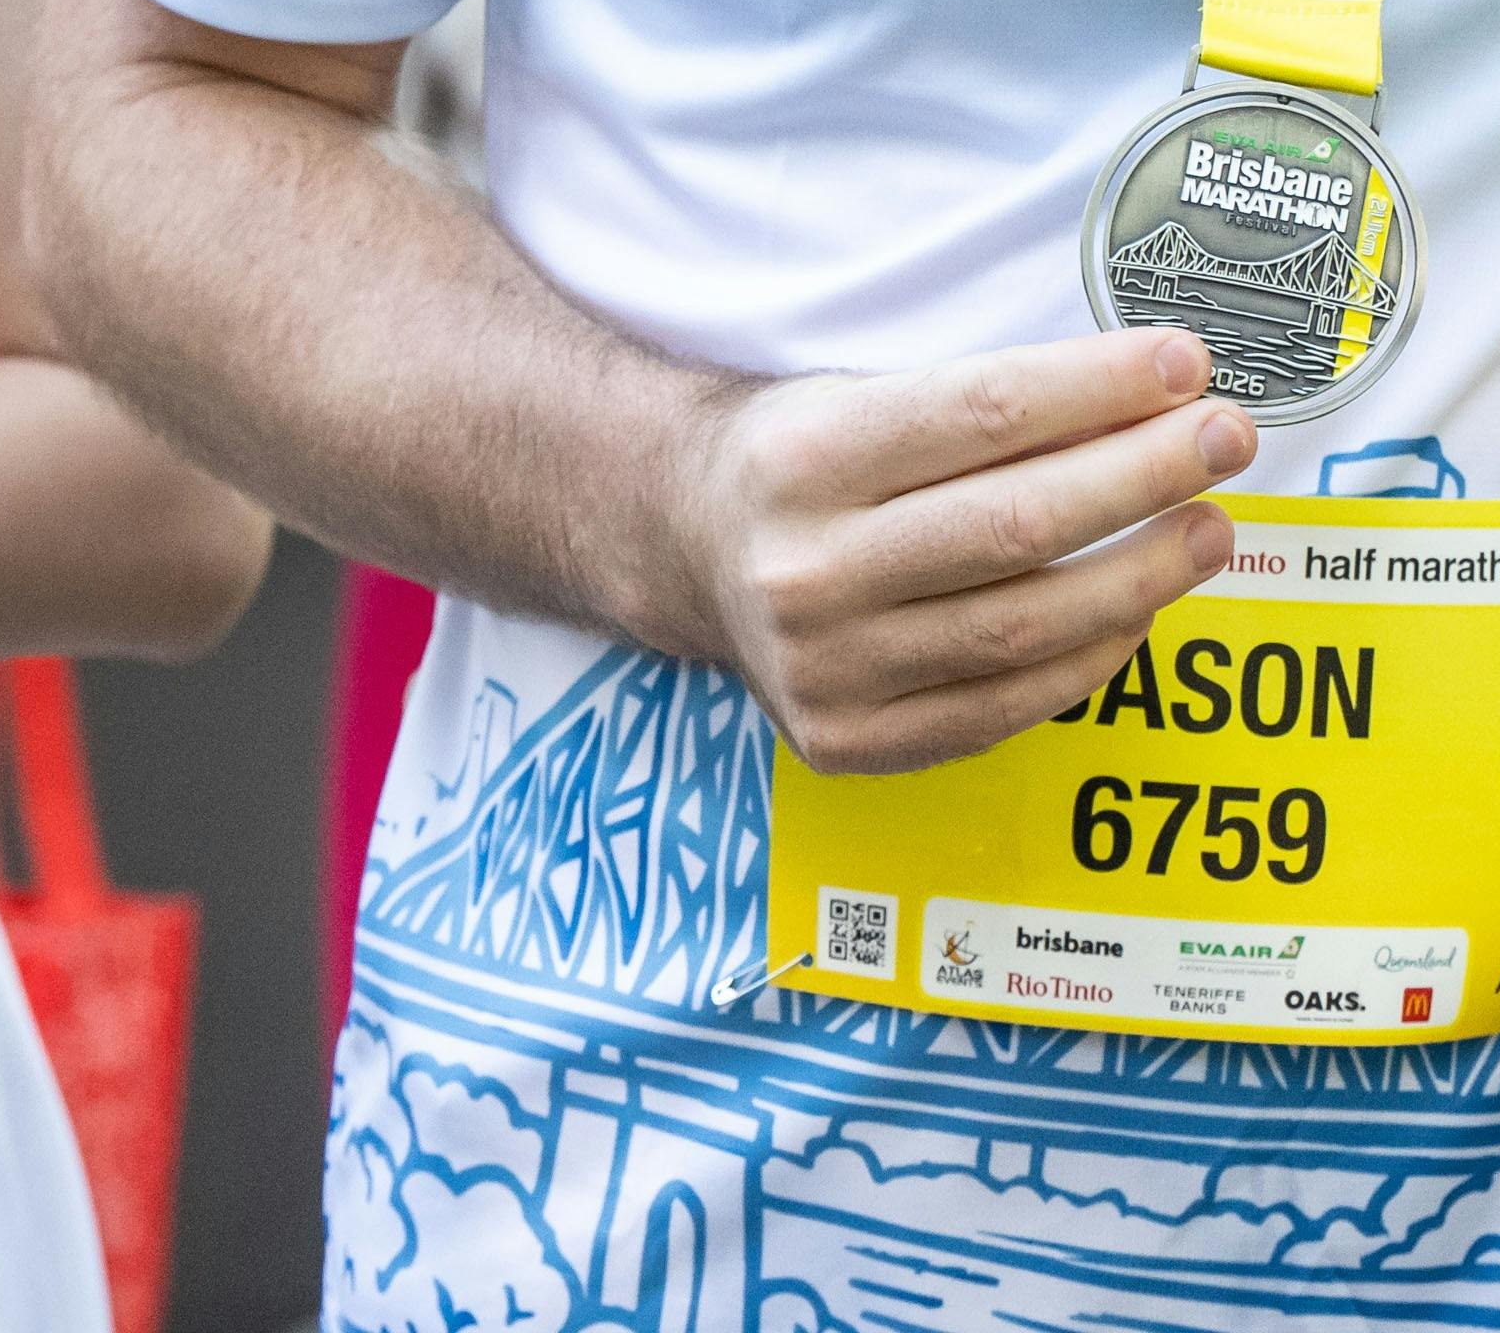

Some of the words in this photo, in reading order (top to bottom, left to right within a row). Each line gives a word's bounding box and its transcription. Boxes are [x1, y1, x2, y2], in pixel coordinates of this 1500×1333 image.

[1214, 131, 1257, 150] EVA
[1263, 140, 1302, 159] AIR
[1186, 140, 1353, 207] Brisbane
[1181, 176, 1349, 233] MARATHON
[1226, 212, 1298, 237] Festival
[1227, 548, 1287, 575] into
[1305, 546, 1377, 581] half
[1047, 636, 1376, 740] ASON
[1071, 775, 1328, 885] 6759
[1016, 926, 1125, 958] brisbane
[1180, 941, 1226, 957] EVA
[1231, 944, 1273, 959] AIR
[937, 964, 984, 982] ATLAS
[1373, 945, 1458, 973] Queensland
[1006, 972, 1113, 1003] RioTinto
[1153, 983, 1246, 1003] TENERIFFE
[1284, 989, 1366, 1013] OAKS.
[1169, 999, 1227, 1015] BANKS
